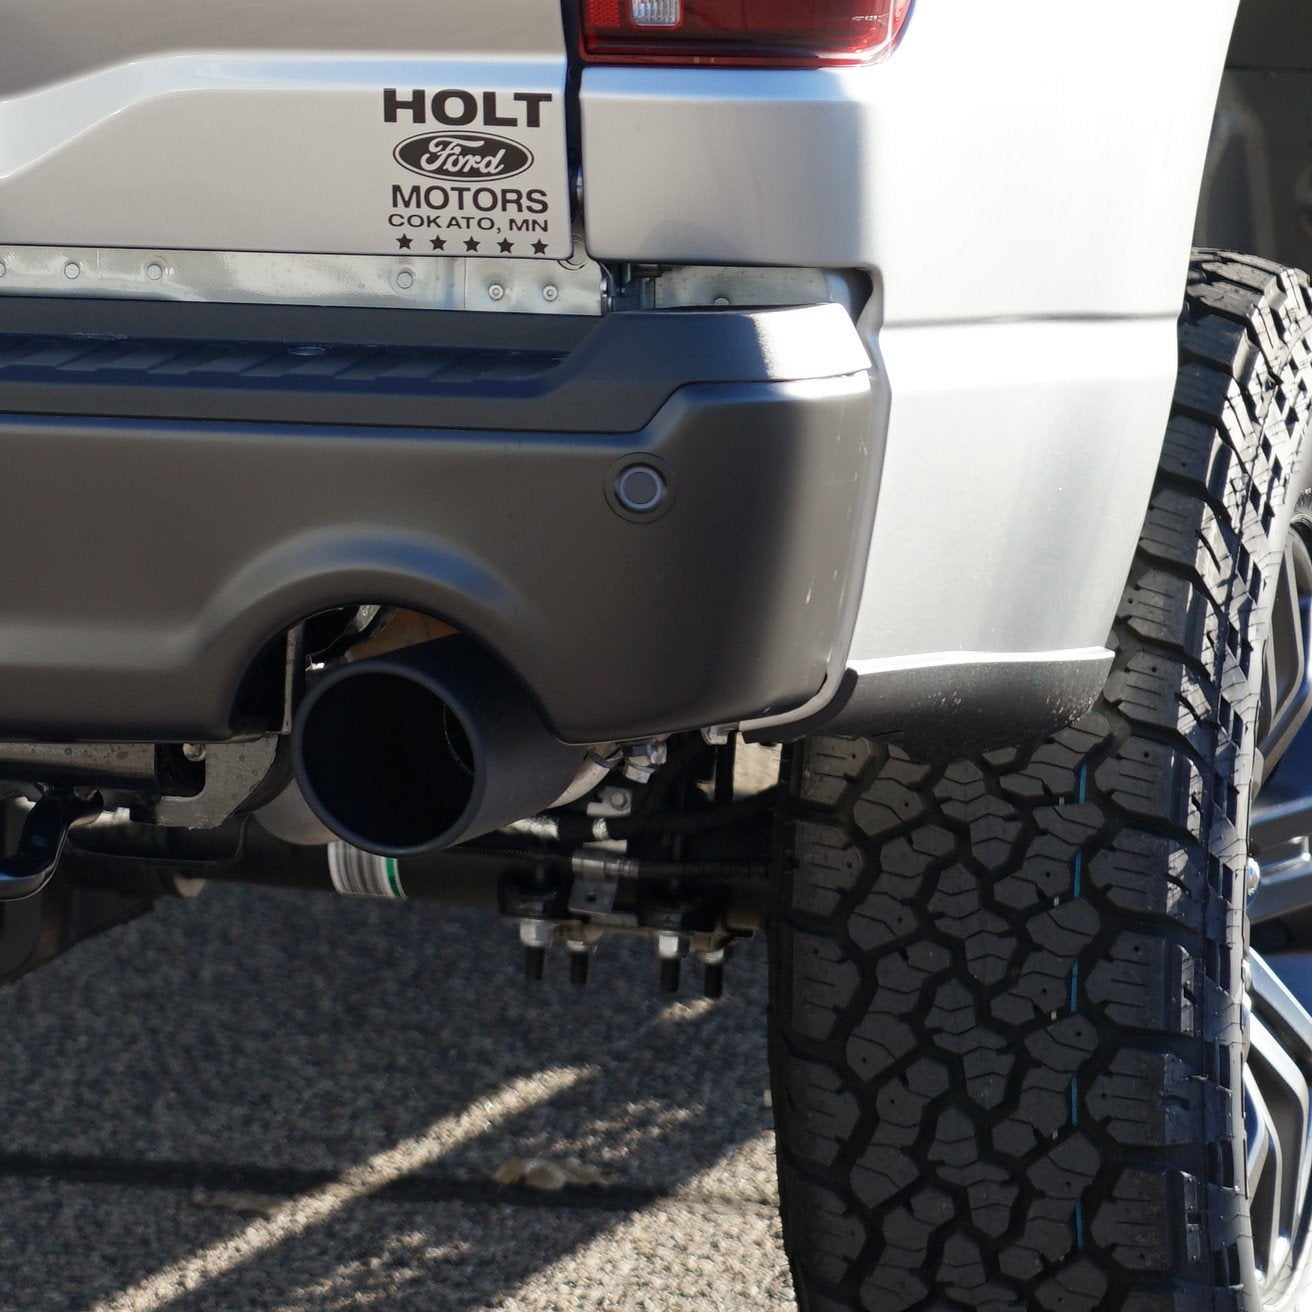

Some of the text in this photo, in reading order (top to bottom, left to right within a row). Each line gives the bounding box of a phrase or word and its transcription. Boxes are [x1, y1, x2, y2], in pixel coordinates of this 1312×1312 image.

[383, 88, 553, 128] HOLT
[420, 137, 506, 174] Ford
[392, 184, 548, 214] MOTORS
[388, 214, 548, 233] COKATO, MN
